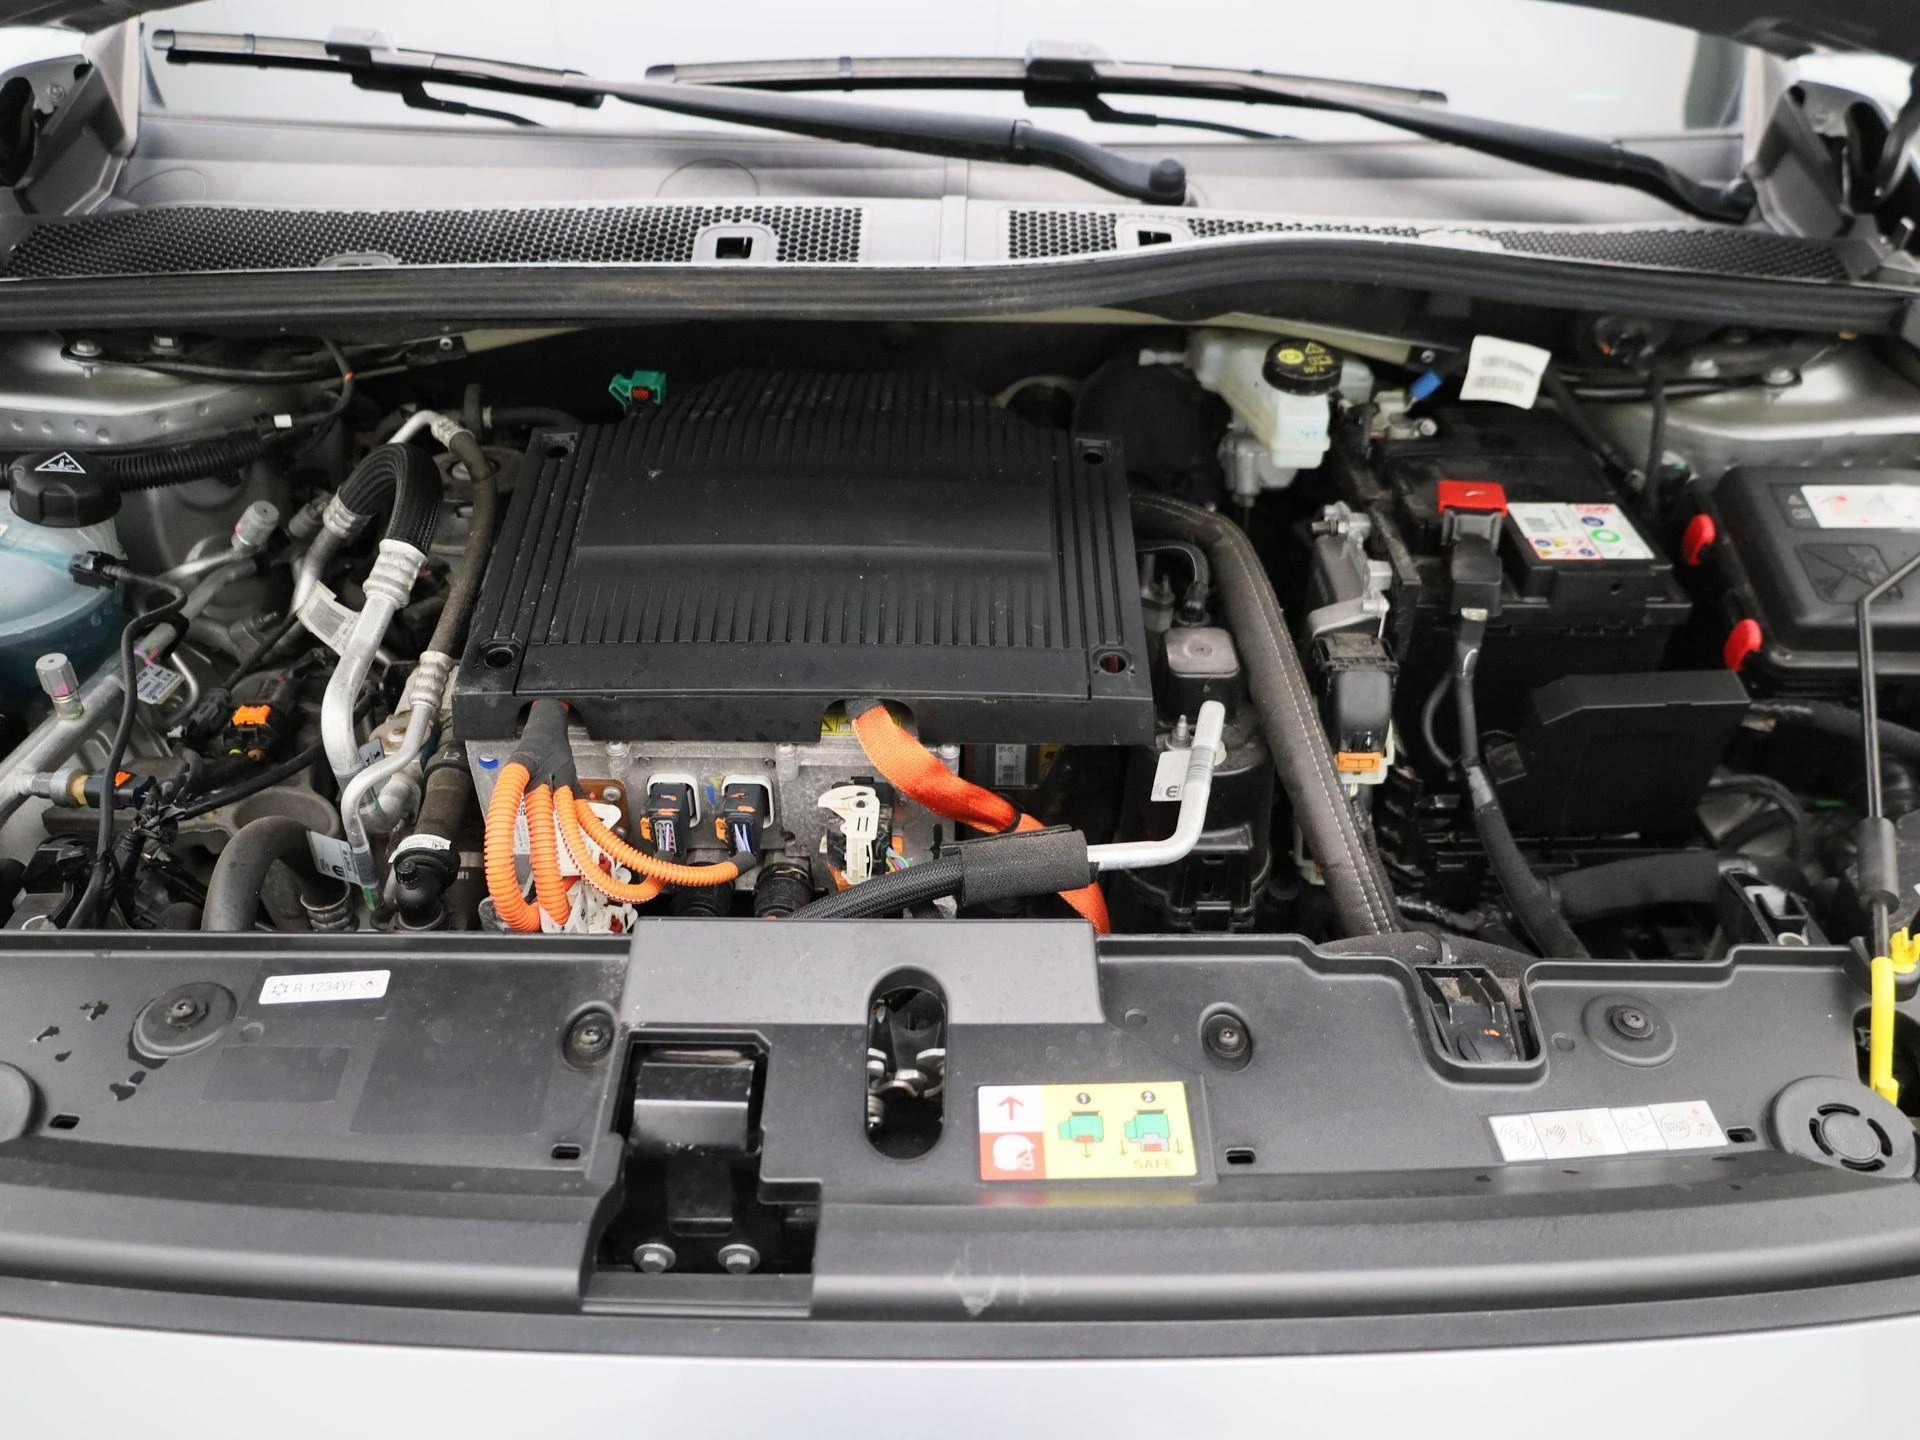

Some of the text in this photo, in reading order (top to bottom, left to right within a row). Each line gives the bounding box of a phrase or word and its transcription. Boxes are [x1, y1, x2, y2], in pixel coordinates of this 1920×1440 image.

[443, 751, 461, 760] L2
[292, 980, 356, 993] R-1234YF
[1133, 1158, 1174, 1170] SAFE
